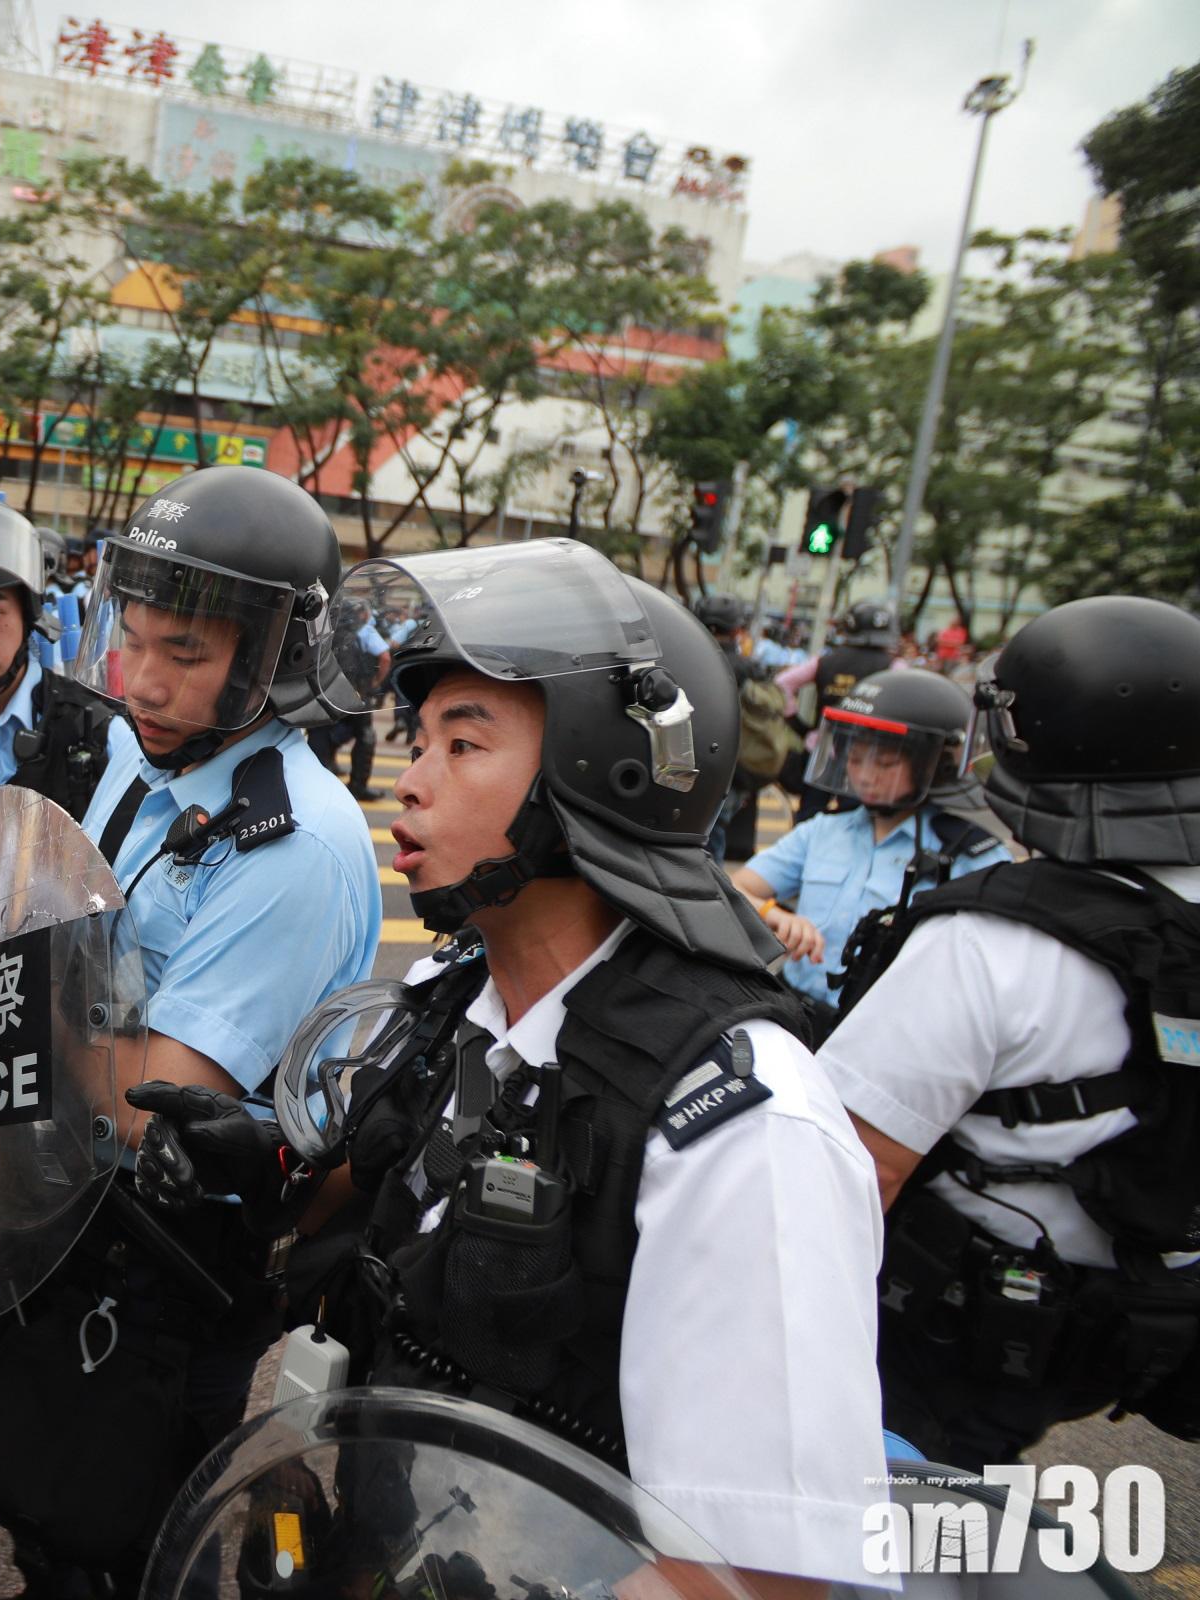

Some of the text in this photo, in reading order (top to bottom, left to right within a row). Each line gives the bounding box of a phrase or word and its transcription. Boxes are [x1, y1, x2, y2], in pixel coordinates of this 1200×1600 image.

[147, 499, 191, 523] 警察
[128, 526, 178, 551] Police
[239, 813, 287, 840] 23201
[682, 1087, 726, 1120] HKP
